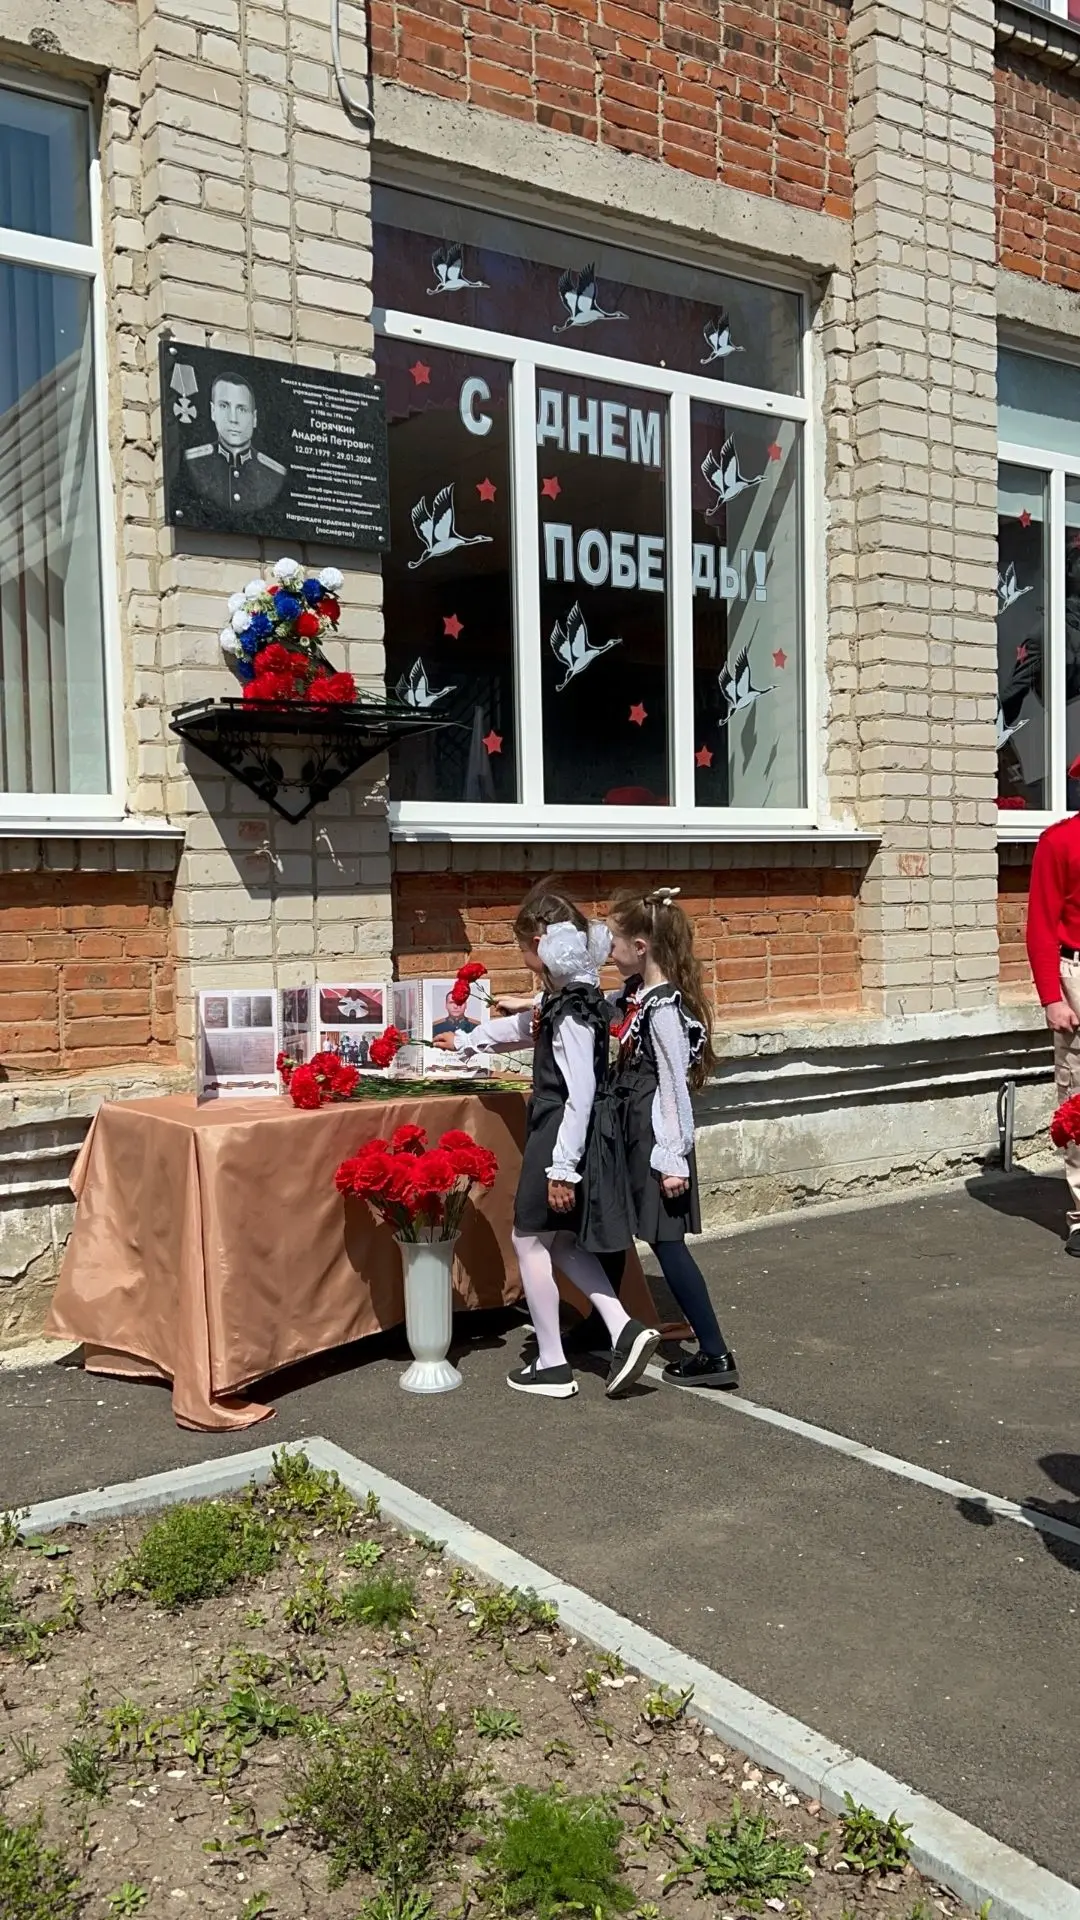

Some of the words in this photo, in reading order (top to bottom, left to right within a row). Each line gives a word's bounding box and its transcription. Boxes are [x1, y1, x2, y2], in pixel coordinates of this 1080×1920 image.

[310, 418, 356, 435] Горячкин
[459, 376, 493, 436] С
[536, 387, 661, 468] ДНЕМ
[291, 428, 328, 443] Андрей
[330, 435, 374, 451] Петрович
[295, 445, 330, 457] 12.07.1979
[336, 451, 372, 464] 29.01.2024
